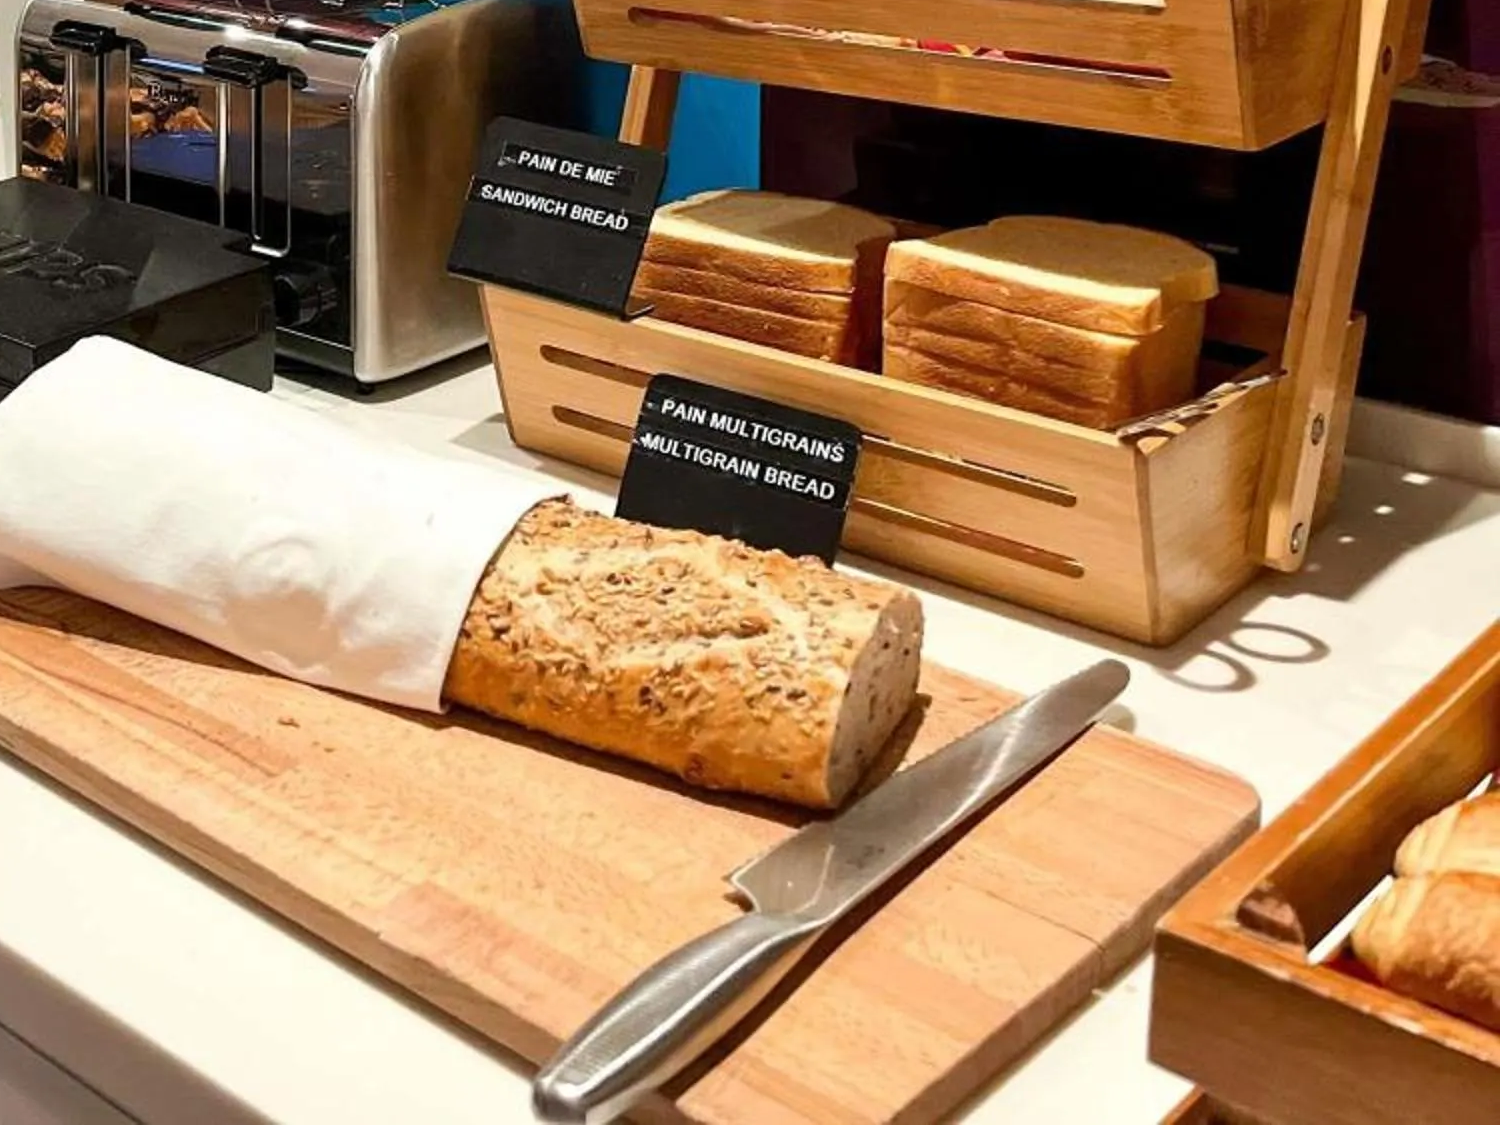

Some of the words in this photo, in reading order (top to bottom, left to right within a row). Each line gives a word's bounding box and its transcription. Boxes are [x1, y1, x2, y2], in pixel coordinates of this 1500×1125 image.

[517, 150, 558, 173] PAIN
[559, 160, 585, 179] DE
[585, 165, 617, 187] MIE
[480, 183, 569, 218] SANDWICH
[569, 203, 629, 231] BREAD
[661, 398, 708, 425] PAIN
[708, 411, 846, 464] MULTIGRAINS
[642, 431, 761, 480] MULTIGRAIN
[763, 465, 836, 501] BREAD
